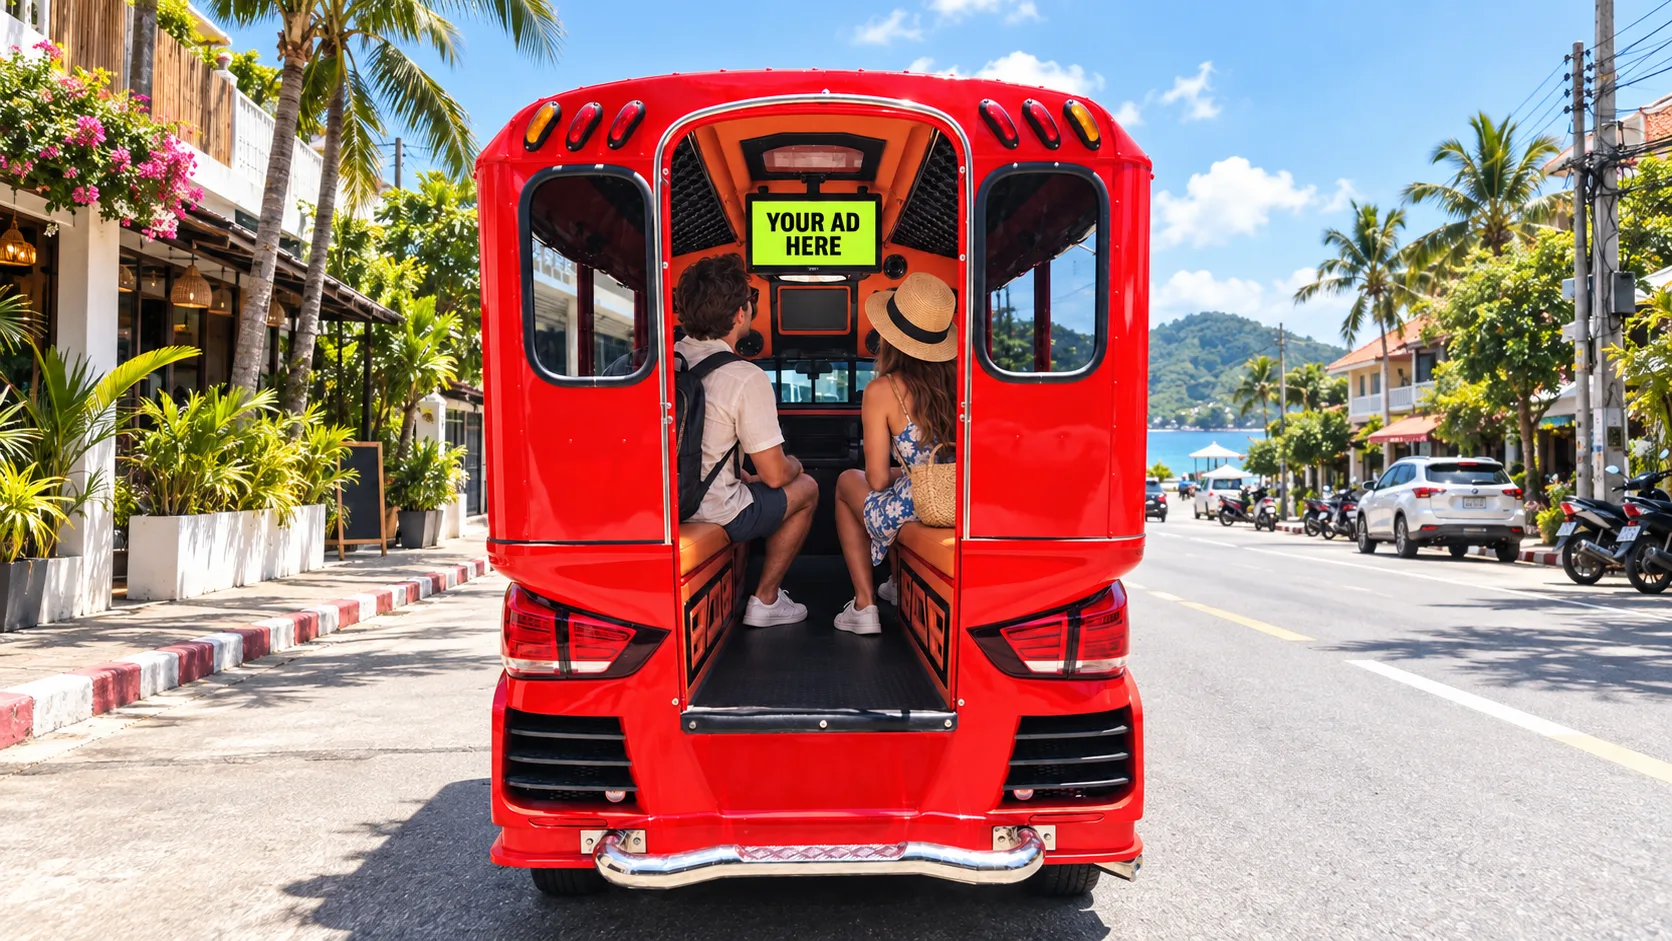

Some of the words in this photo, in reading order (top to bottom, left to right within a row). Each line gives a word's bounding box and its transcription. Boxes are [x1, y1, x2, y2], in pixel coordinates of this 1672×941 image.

[767, 212, 824, 232] YOUR
[831, 212, 860, 232] AD
[786, 236, 841, 256] HERE
